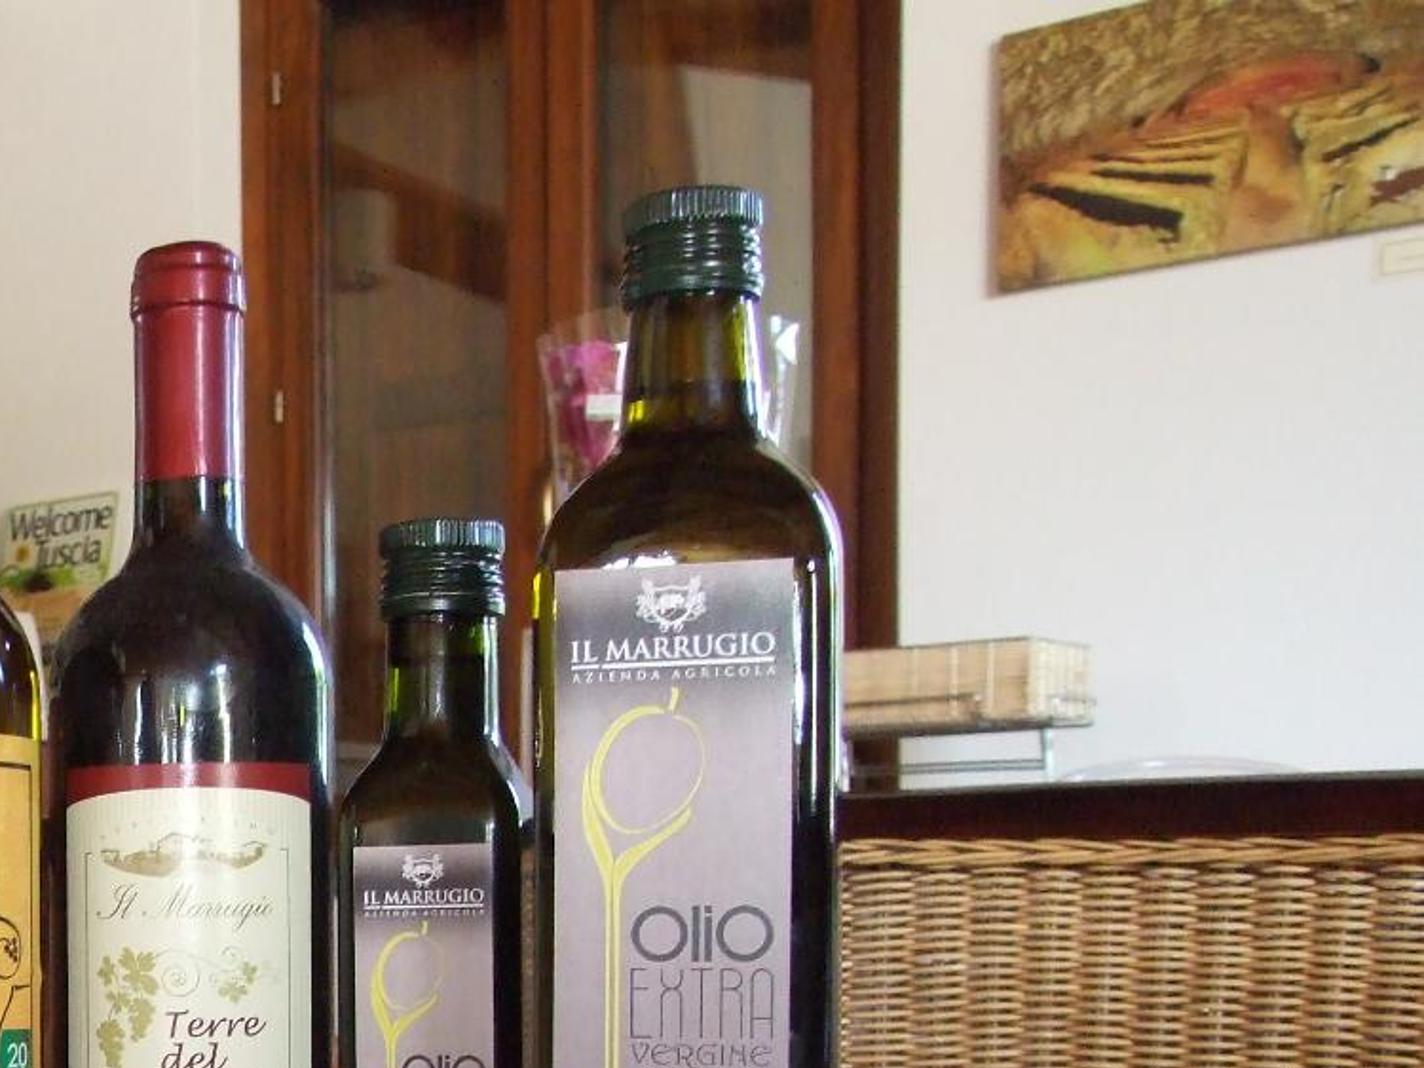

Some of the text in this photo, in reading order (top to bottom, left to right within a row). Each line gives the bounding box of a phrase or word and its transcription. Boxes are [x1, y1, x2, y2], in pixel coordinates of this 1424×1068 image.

[10, 504, 113, 541] Welcome
[34, 536, 102, 571] Tuscia
[571, 632, 776, 663] IL MARRUGIO
[573, 666, 776, 683] AZIENDA AGRICOLA
[363, 887, 485, 904] IL MARRUGIO
[629, 967, 775, 1040] EXTRA
[164, 1010, 267, 1039] Terre
[7, 1041, 28, 1067] 20
